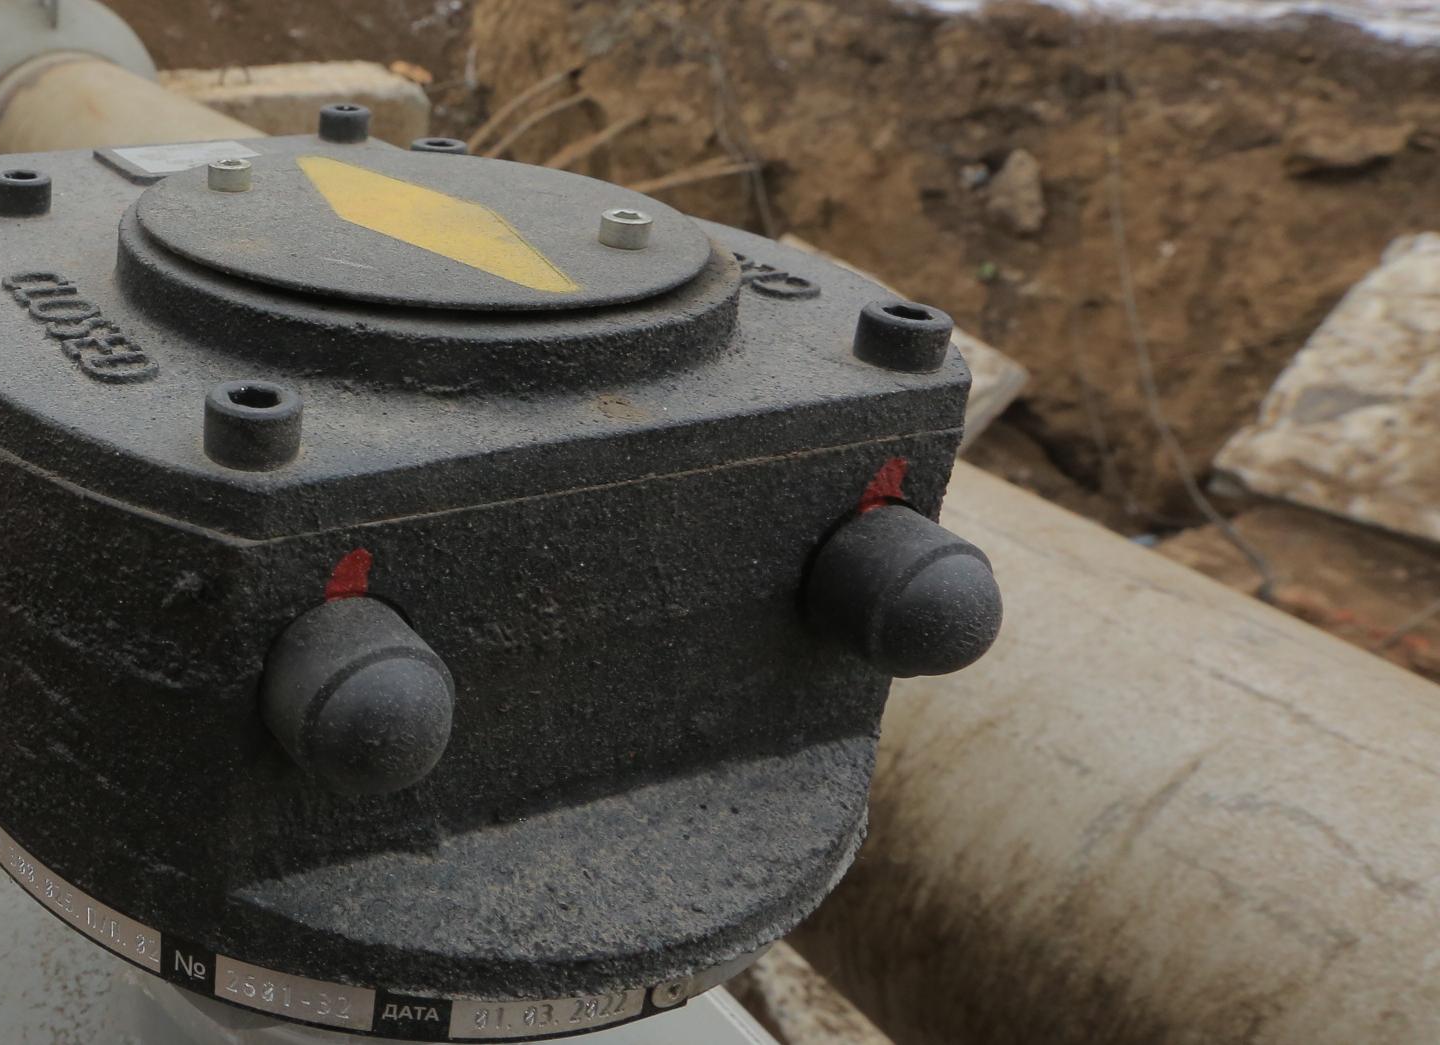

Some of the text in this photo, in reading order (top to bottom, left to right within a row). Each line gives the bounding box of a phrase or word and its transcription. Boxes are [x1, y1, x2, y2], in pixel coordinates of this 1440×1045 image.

[1, 271, 160, 385] CLOSED
[173, 950, 207, 980] №
[381, 1003, 440, 1022] ДАТА
